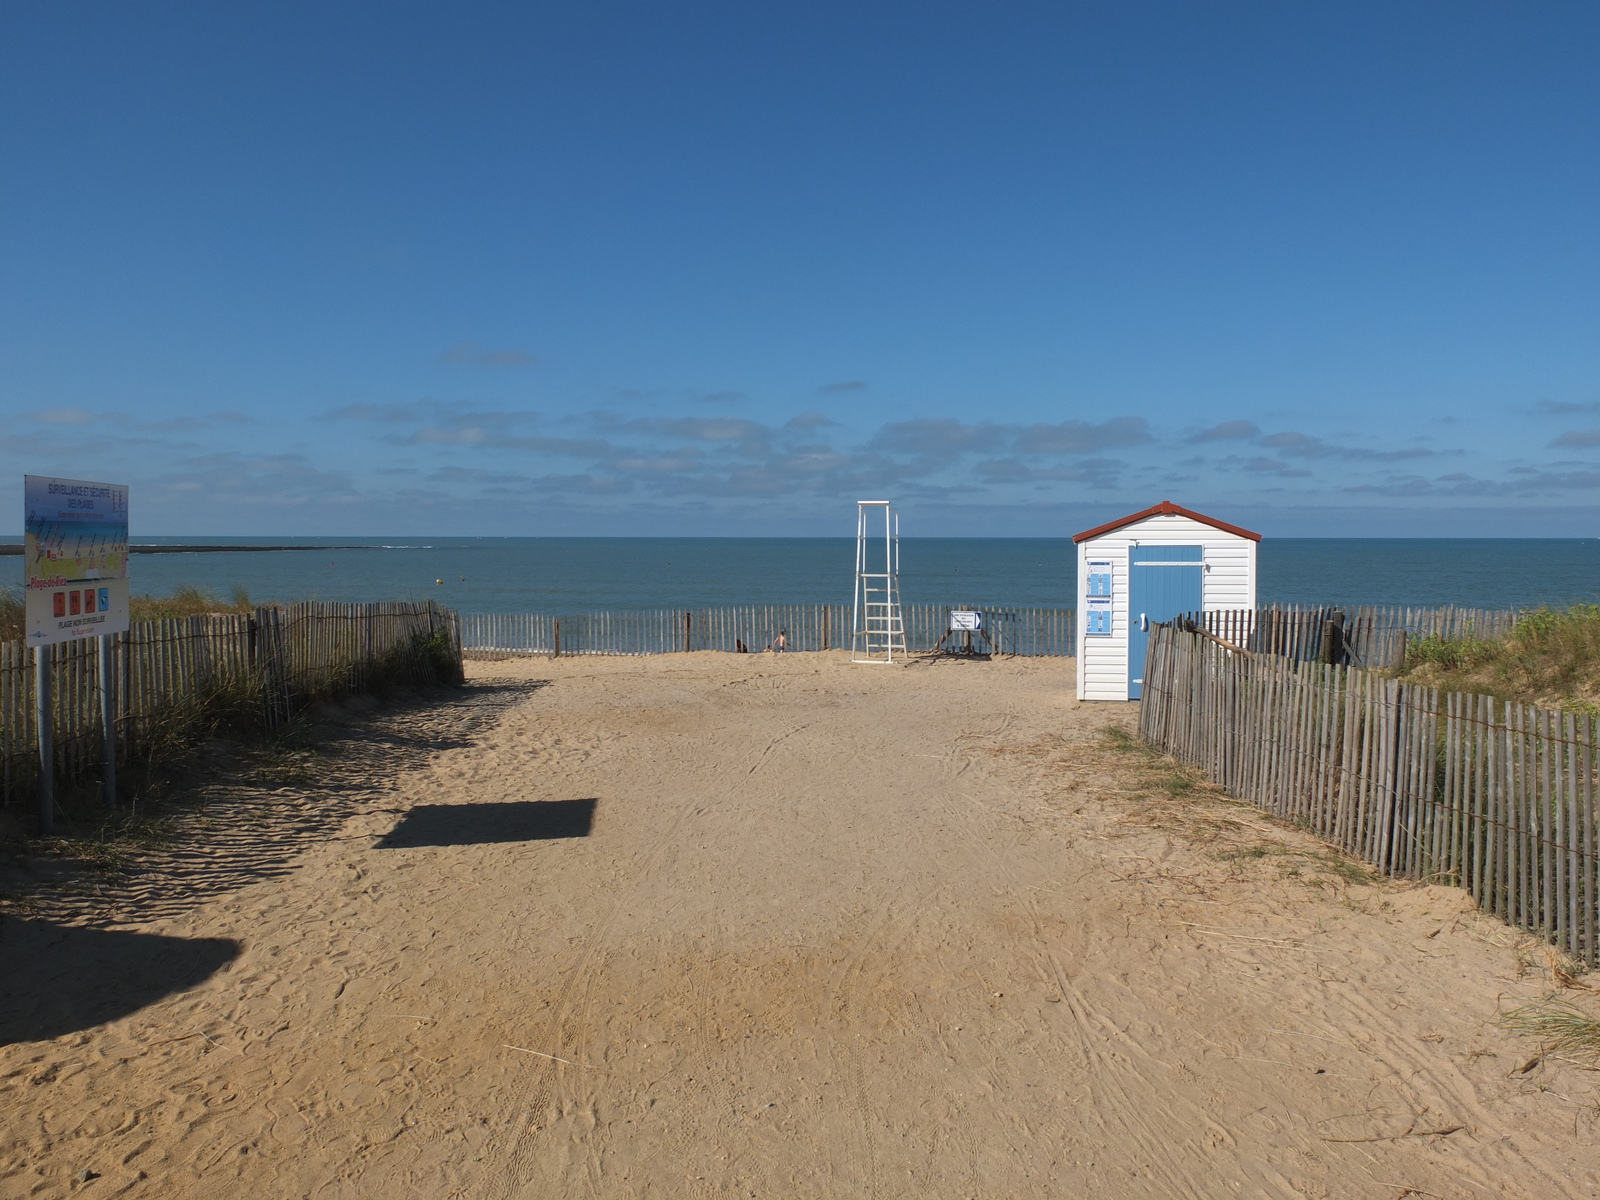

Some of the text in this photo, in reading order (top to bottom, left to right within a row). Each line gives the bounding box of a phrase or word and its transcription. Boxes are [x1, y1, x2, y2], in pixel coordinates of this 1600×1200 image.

[48, 483, 111, 498] SURVEILLANCE ET SÉCURITÉ
[67, 498, 94, 509] DES PLAGES
[58, 620, 72, 629] PLAGE
[73, 619, 81, 627] NON
